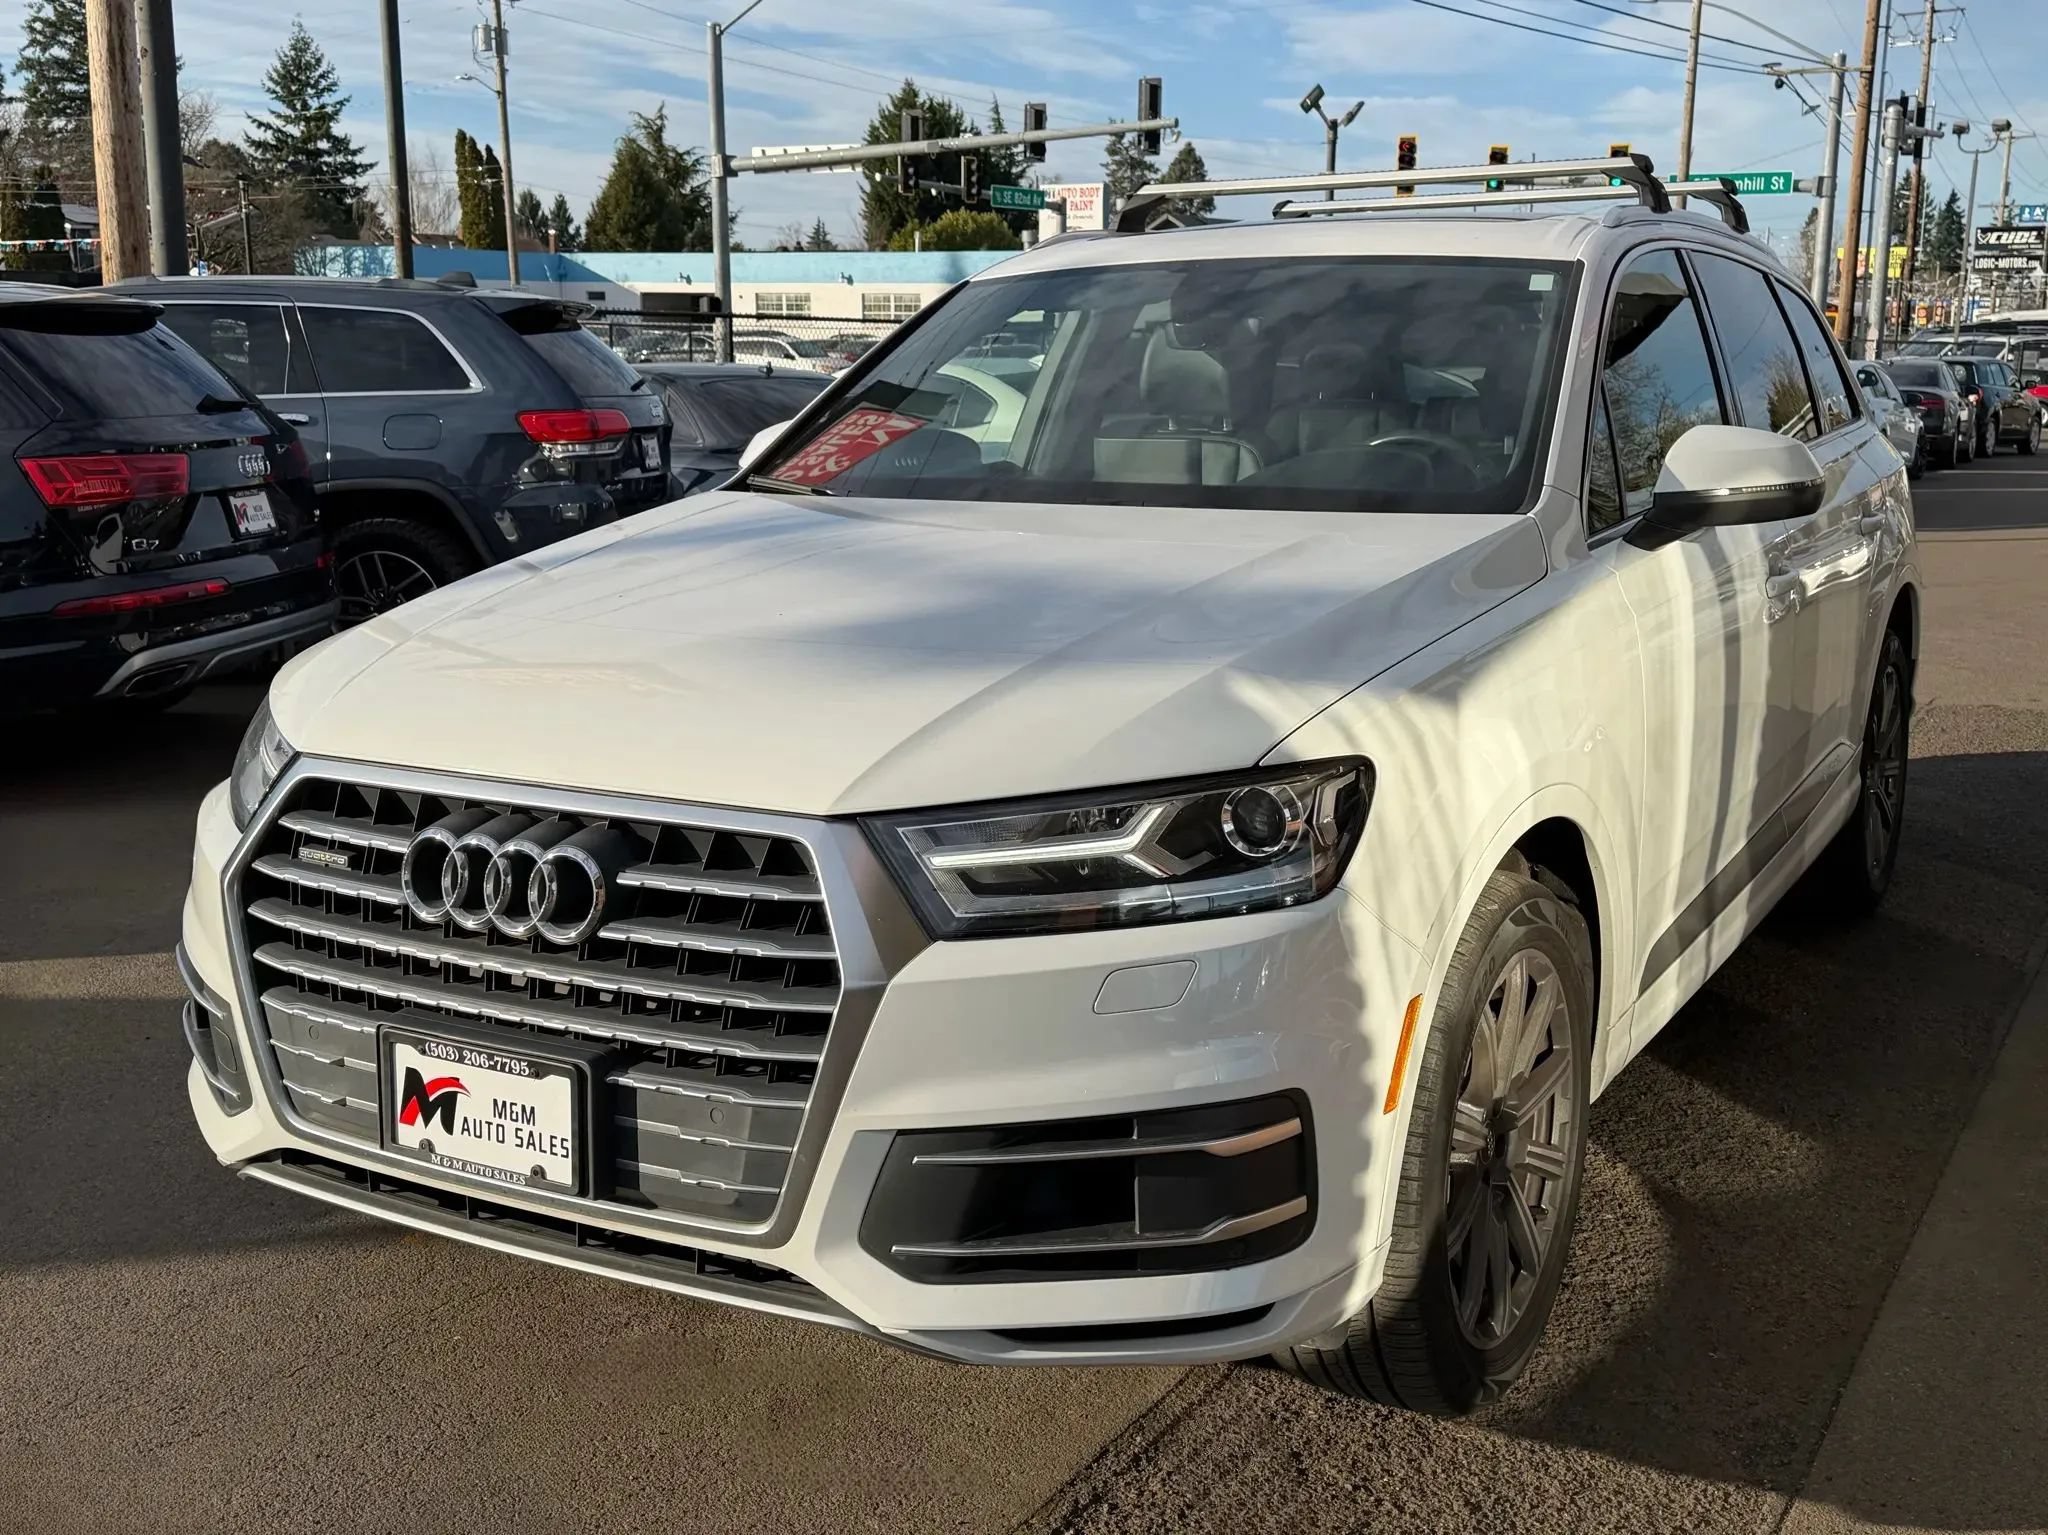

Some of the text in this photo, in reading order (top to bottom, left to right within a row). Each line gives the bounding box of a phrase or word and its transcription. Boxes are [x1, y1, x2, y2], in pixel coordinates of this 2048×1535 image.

[1771, 176, 1784, 190] St
[1003, 191, 1012, 203] SE
[1014, 192, 1031, 205] 82nd
[1057, 188, 1077, 199] AUTO
[1080, 187, 1100, 198] BODY
[1070, 201, 1094, 211] PAINT
[131, 538, 159, 551] Q7
[300, 850, 345, 864] quattro
[424, 1041, 530, 1077] (503) 206-7795
[492, 1098, 536, 1127] M&M
[461, 1116, 570, 1160] AUTO SALES
[431, 1154, 526, 1185] M & M AUTO SALES
